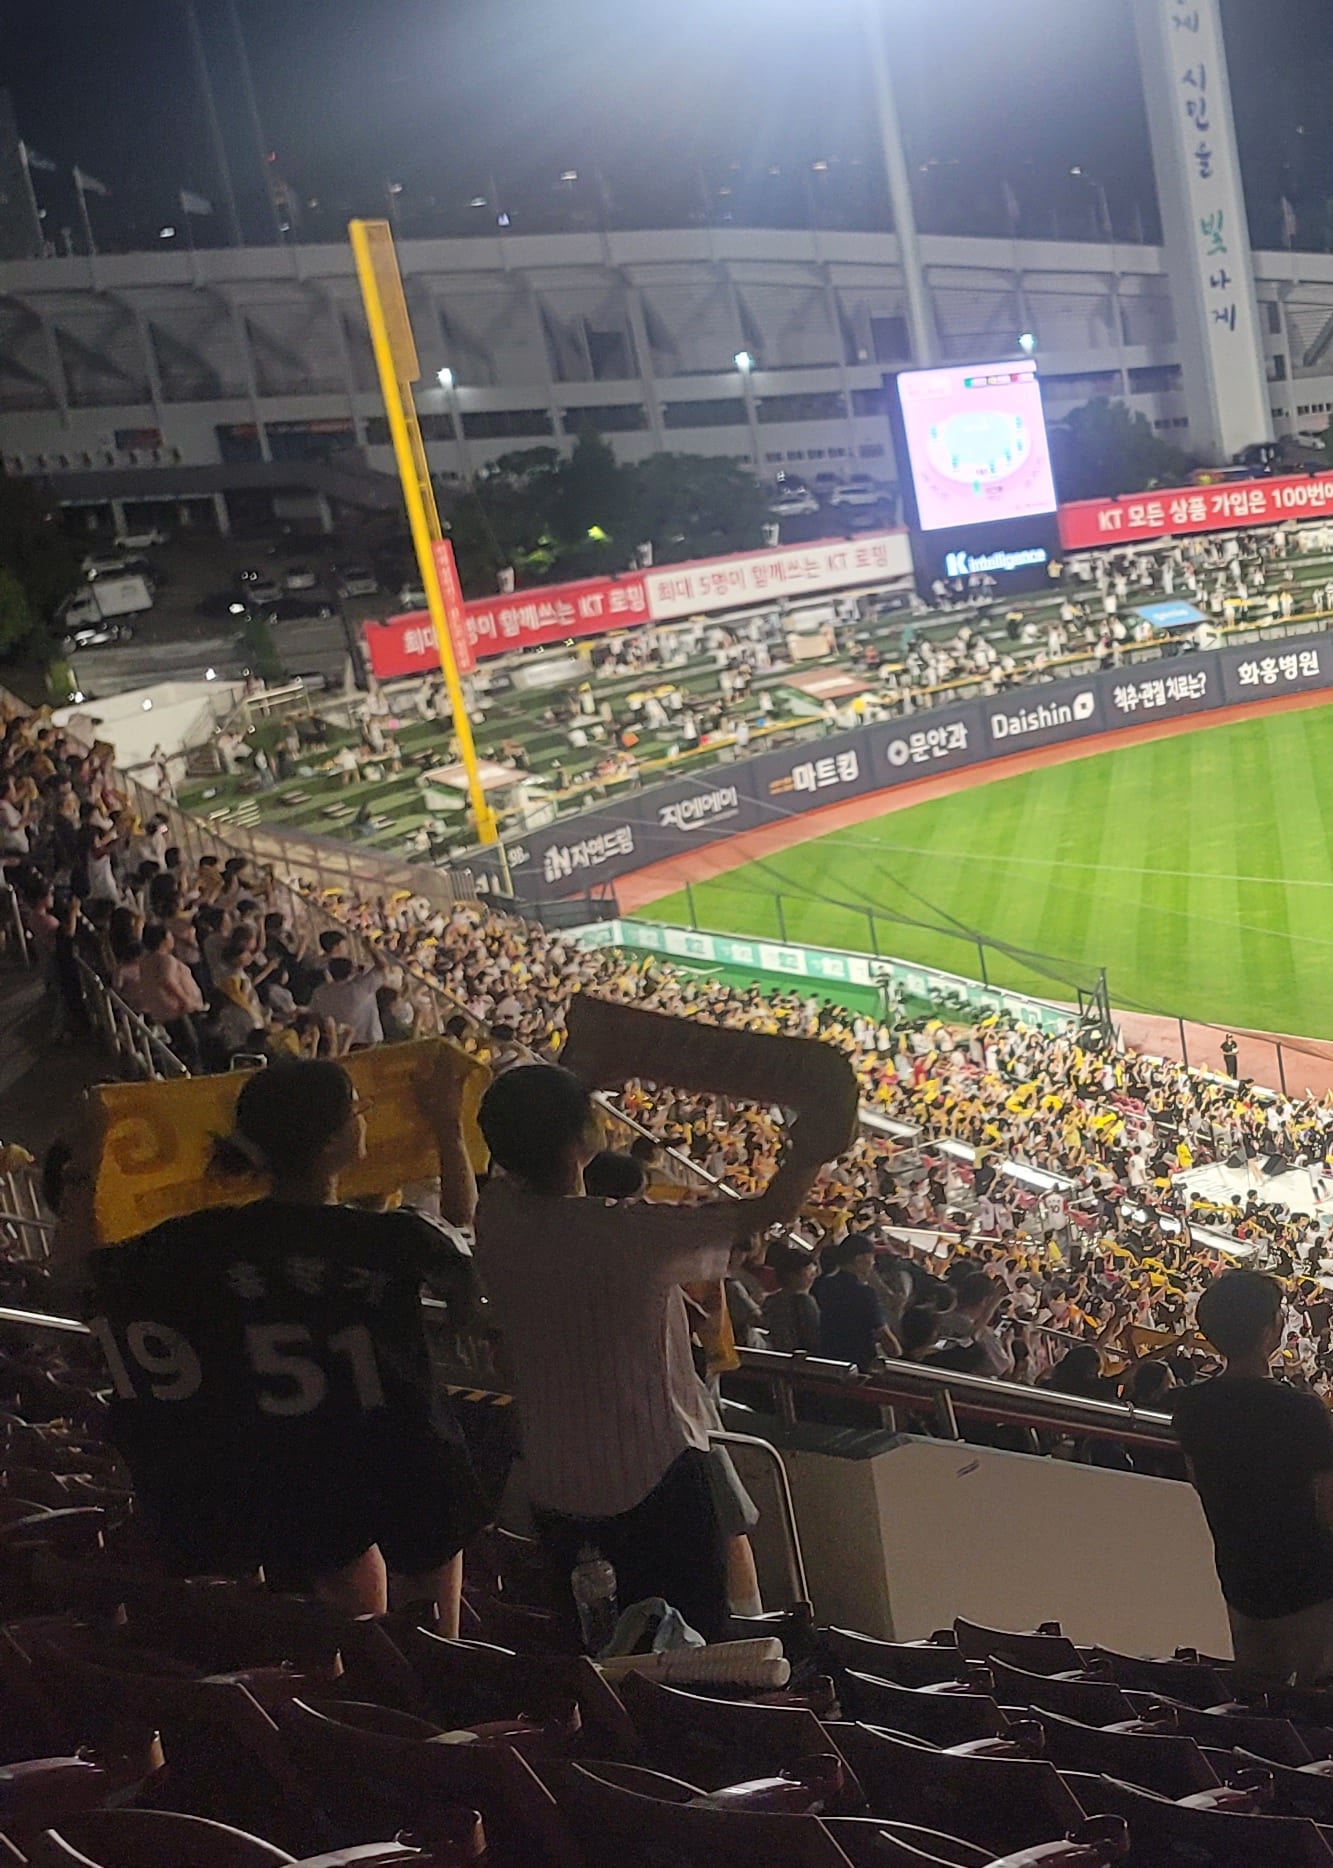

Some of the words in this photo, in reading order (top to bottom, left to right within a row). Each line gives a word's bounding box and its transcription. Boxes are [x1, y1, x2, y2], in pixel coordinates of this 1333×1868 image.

[1181, 63, 1213, 178] 시민을
[1199, 208, 1236, 332] 빛나게
[1098, 508, 1122, 531] KT
[1128, 503, 1165, 528] 모든
[1169, 498, 1208, 523] 상품
[1212, 491, 1267, 518] 가입은
[657, 578, 694, 604] 최대
[699, 570, 745, 598] 5명이
[750, 558, 819, 593] 함께쓰는
[826, 552, 848, 572] KT
[855, 543, 890, 569] 로밍
[968, 547, 1049, 573] intelligence
[500, 600, 575, 639] 함께쓰는
[579, 590, 605, 617] KT
[608, 584, 646, 614] 로밍
[1167, 671, 1207, 703] 치료는?
[1238, 650, 1320, 688] 화홍병원
[991, 700, 1072, 740] Daishin
[909, 721, 969, 764] 문안과
[793, 749, 860, 794] 마트킹
[572, 825, 635, 868] 자연드림
[89, 1314, 203, 1402] 19
[245, 1322, 387, 1417] 51
